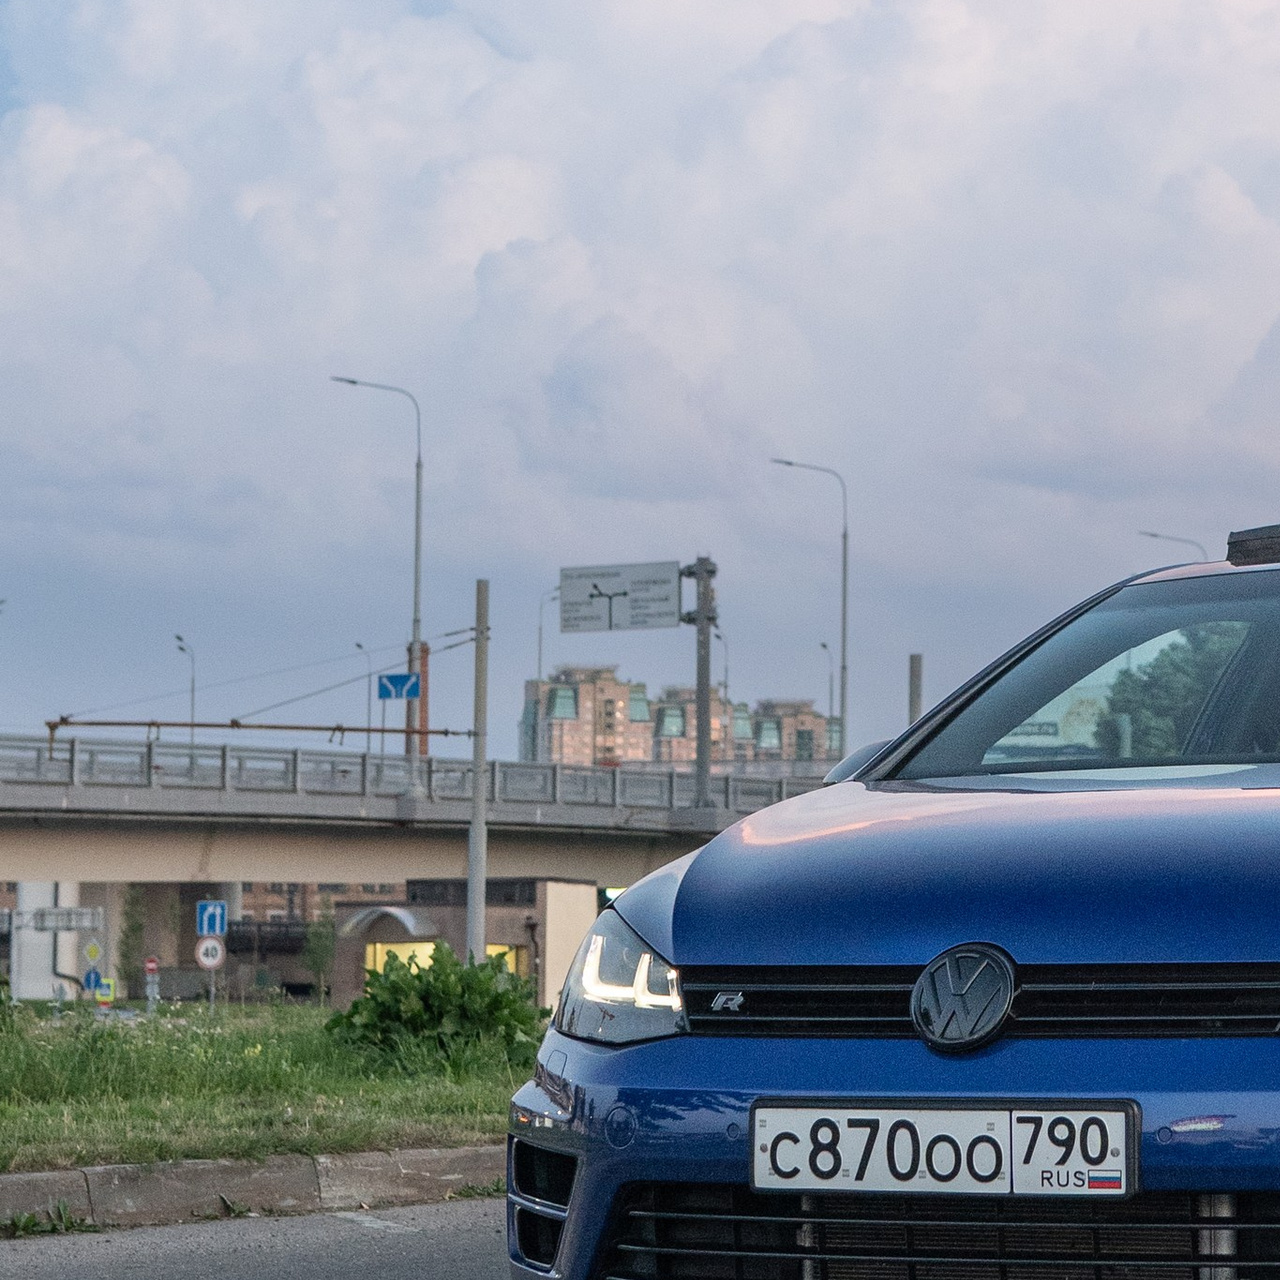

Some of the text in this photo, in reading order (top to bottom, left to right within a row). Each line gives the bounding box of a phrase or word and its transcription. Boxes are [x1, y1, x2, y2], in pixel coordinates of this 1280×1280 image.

[203, 946, 218, 958] 40
[711, 991, 744, 1011] R
[1015, 1115, 1109, 1167] 790
[1040, 1170, 1086, 1188] RUS
